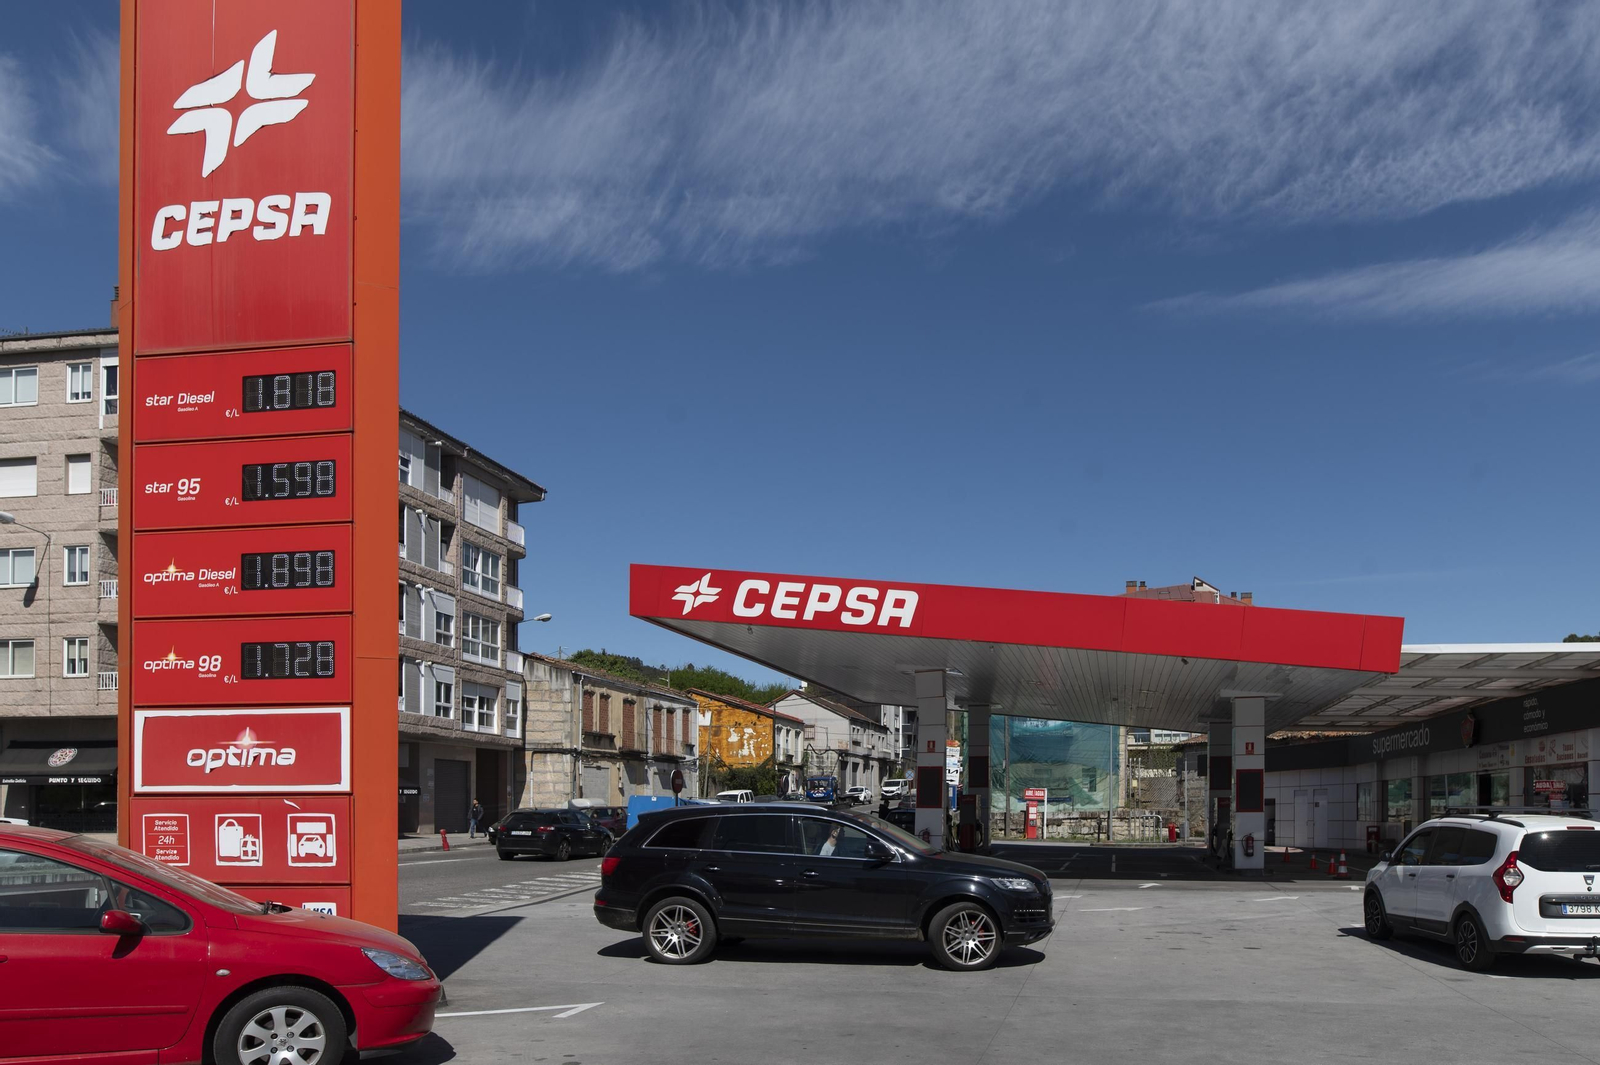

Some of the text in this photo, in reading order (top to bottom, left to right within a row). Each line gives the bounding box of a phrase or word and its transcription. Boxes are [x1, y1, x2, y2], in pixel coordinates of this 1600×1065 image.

[151, 192, 332, 251] CEPSA
[145, 390, 215, 407] star Diesel
[258, 371, 335, 410] 1.818
[225, 408, 240, 418] €/L
[144, 478, 201, 495] star 95
[257, 460, 334, 498] 1.598
[224, 496, 240, 506] €/L
[143, 567, 237, 586] optima Diesel
[256, 551, 334, 588] 1.898
[223, 585, 239, 595] €/L
[732, 579, 920, 628] CEPSA
[143, 655, 222, 674] optima 98
[256, 641, 334, 678] 1.728
[223, 674, 239, 684] €/L
[1372, 722, 1430, 759] supermercado
[186, 746, 297, 774] optima
[154, 819, 178, 827] Servicio
[157, 835, 175, 845] 24h
[1568, 904, 1592, 914] 3798
